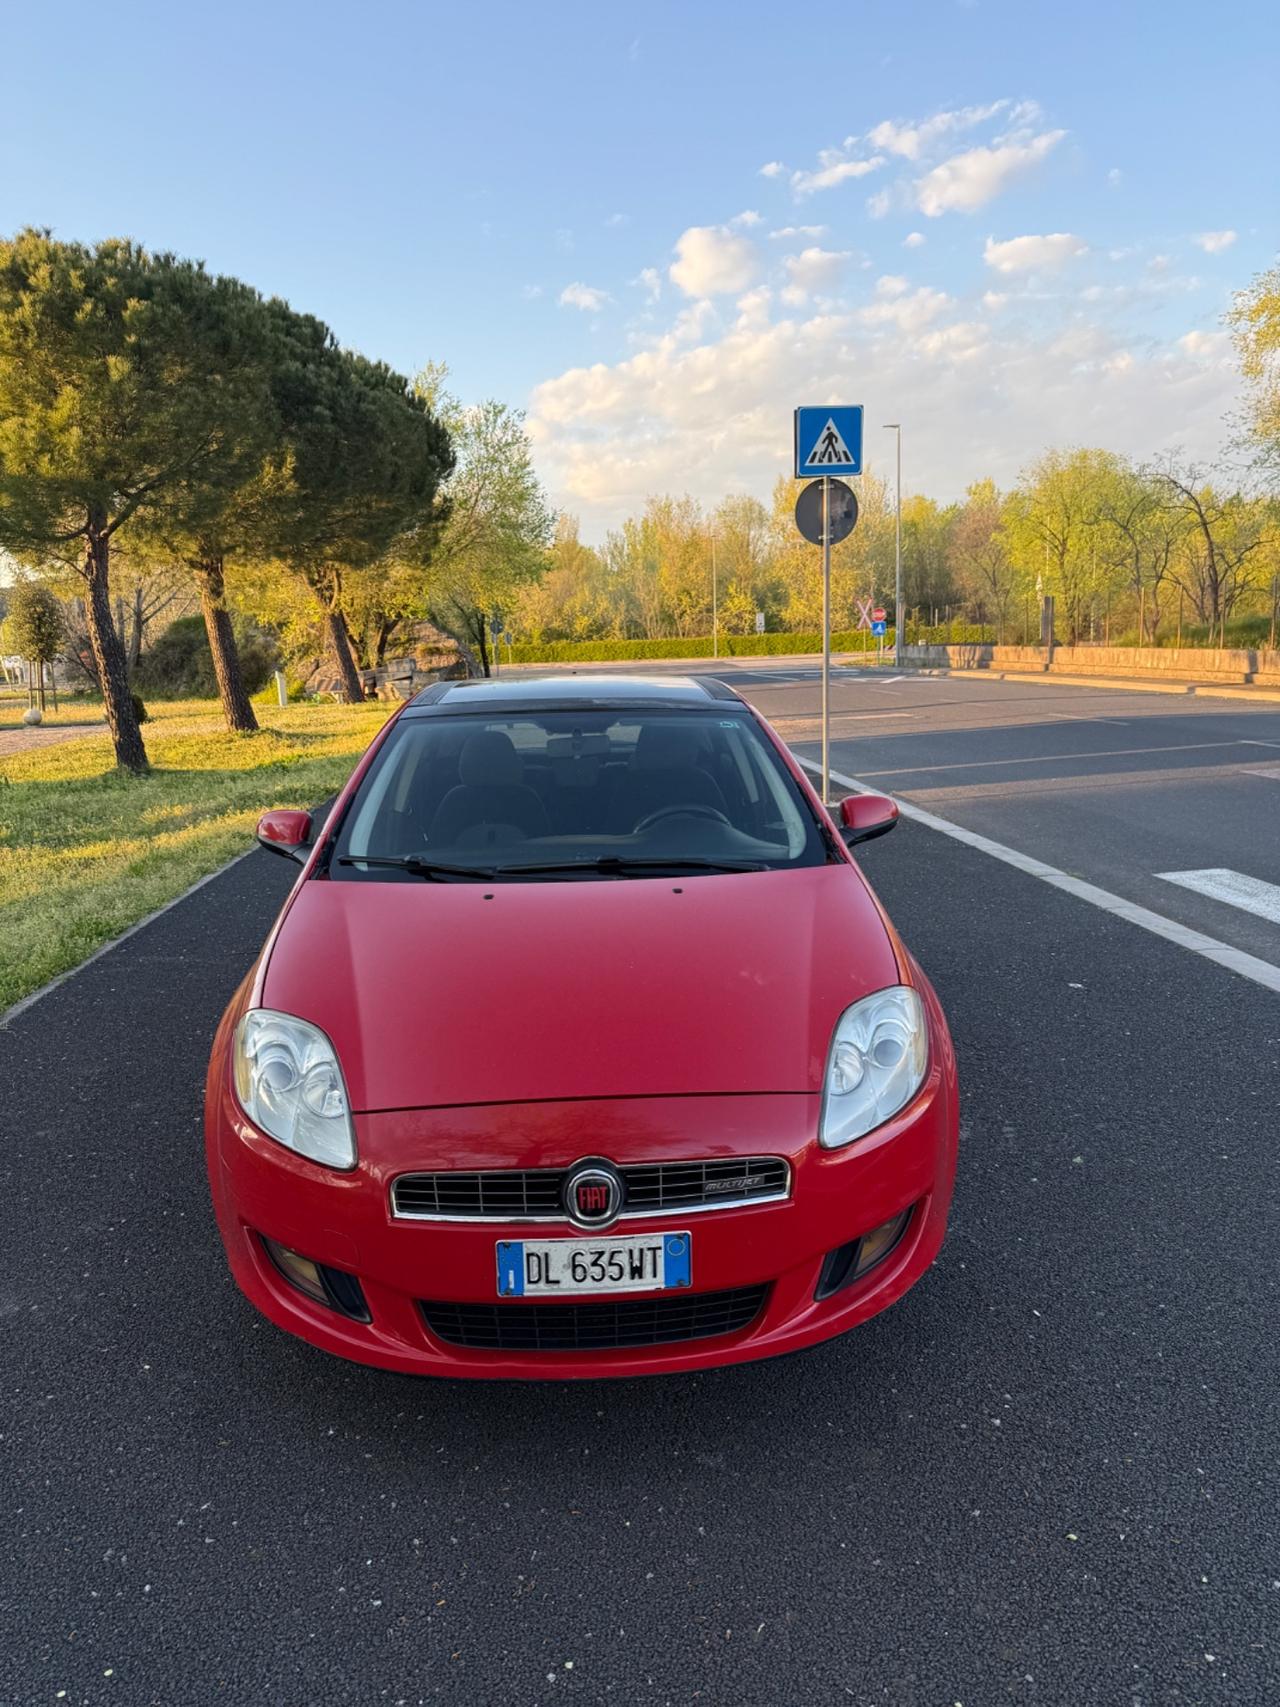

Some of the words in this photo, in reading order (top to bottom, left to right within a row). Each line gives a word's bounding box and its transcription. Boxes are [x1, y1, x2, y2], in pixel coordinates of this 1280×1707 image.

[578, 1186, 608, 1210] FIAT
[526, 1252, 560, 1284] DL
[571, 1246, 662, 1282] 635WT
